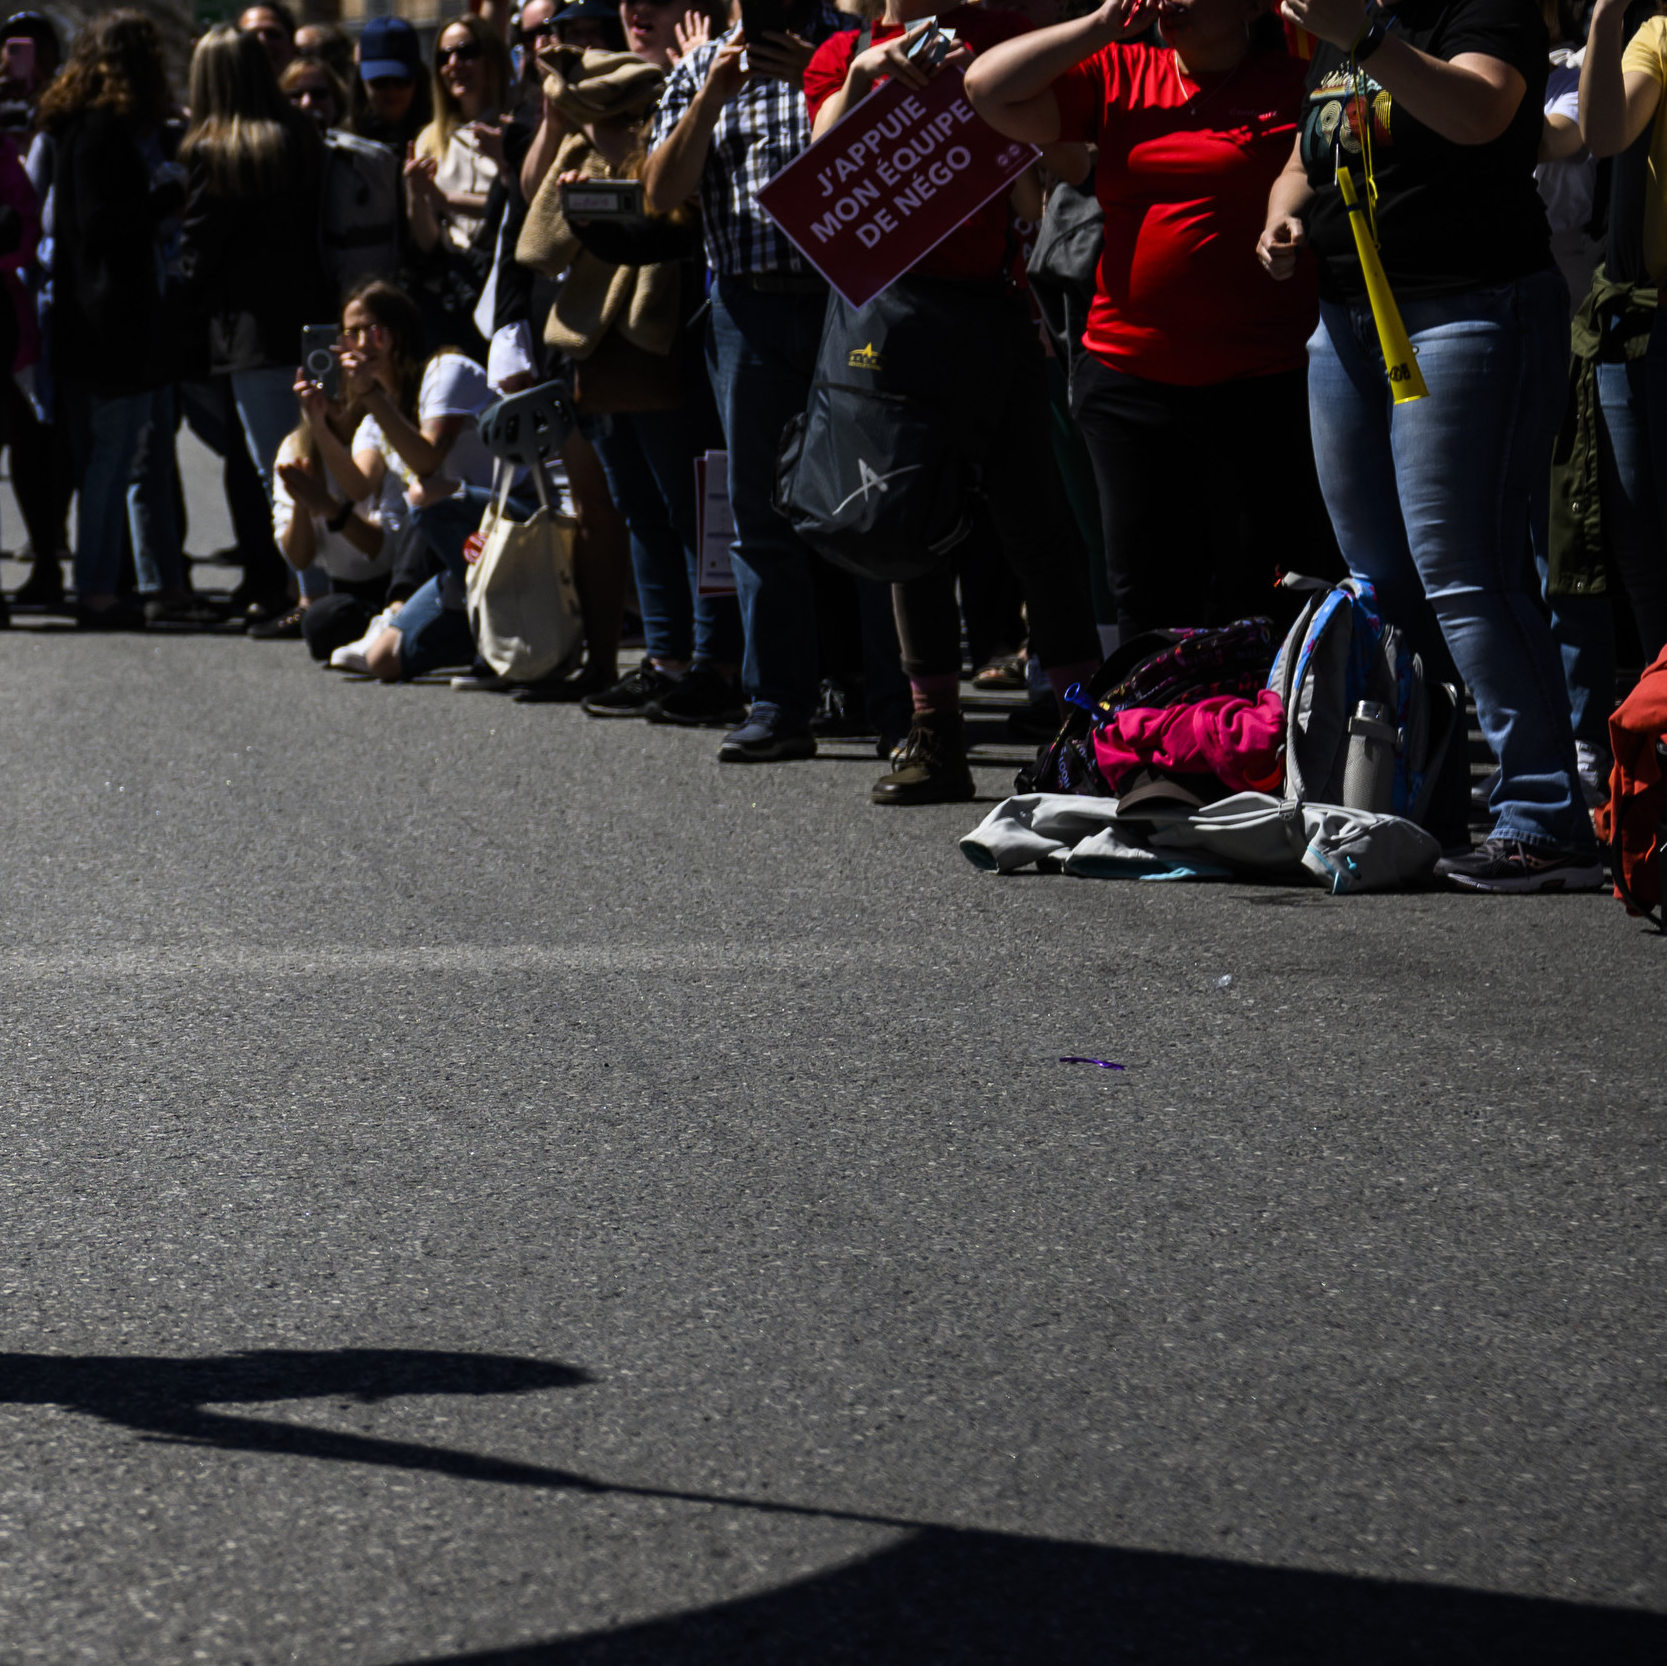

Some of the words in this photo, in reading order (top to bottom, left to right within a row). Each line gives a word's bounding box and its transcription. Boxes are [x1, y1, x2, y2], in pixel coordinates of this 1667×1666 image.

[810, 180, 881, 244] MON
[875, 98, 974, 187] ÉQUIPE
[817, 95, 927, 198] J'APPUIE
[855, 209, 899, 250] DE
[896, 145, 972, 217] NÉGO
